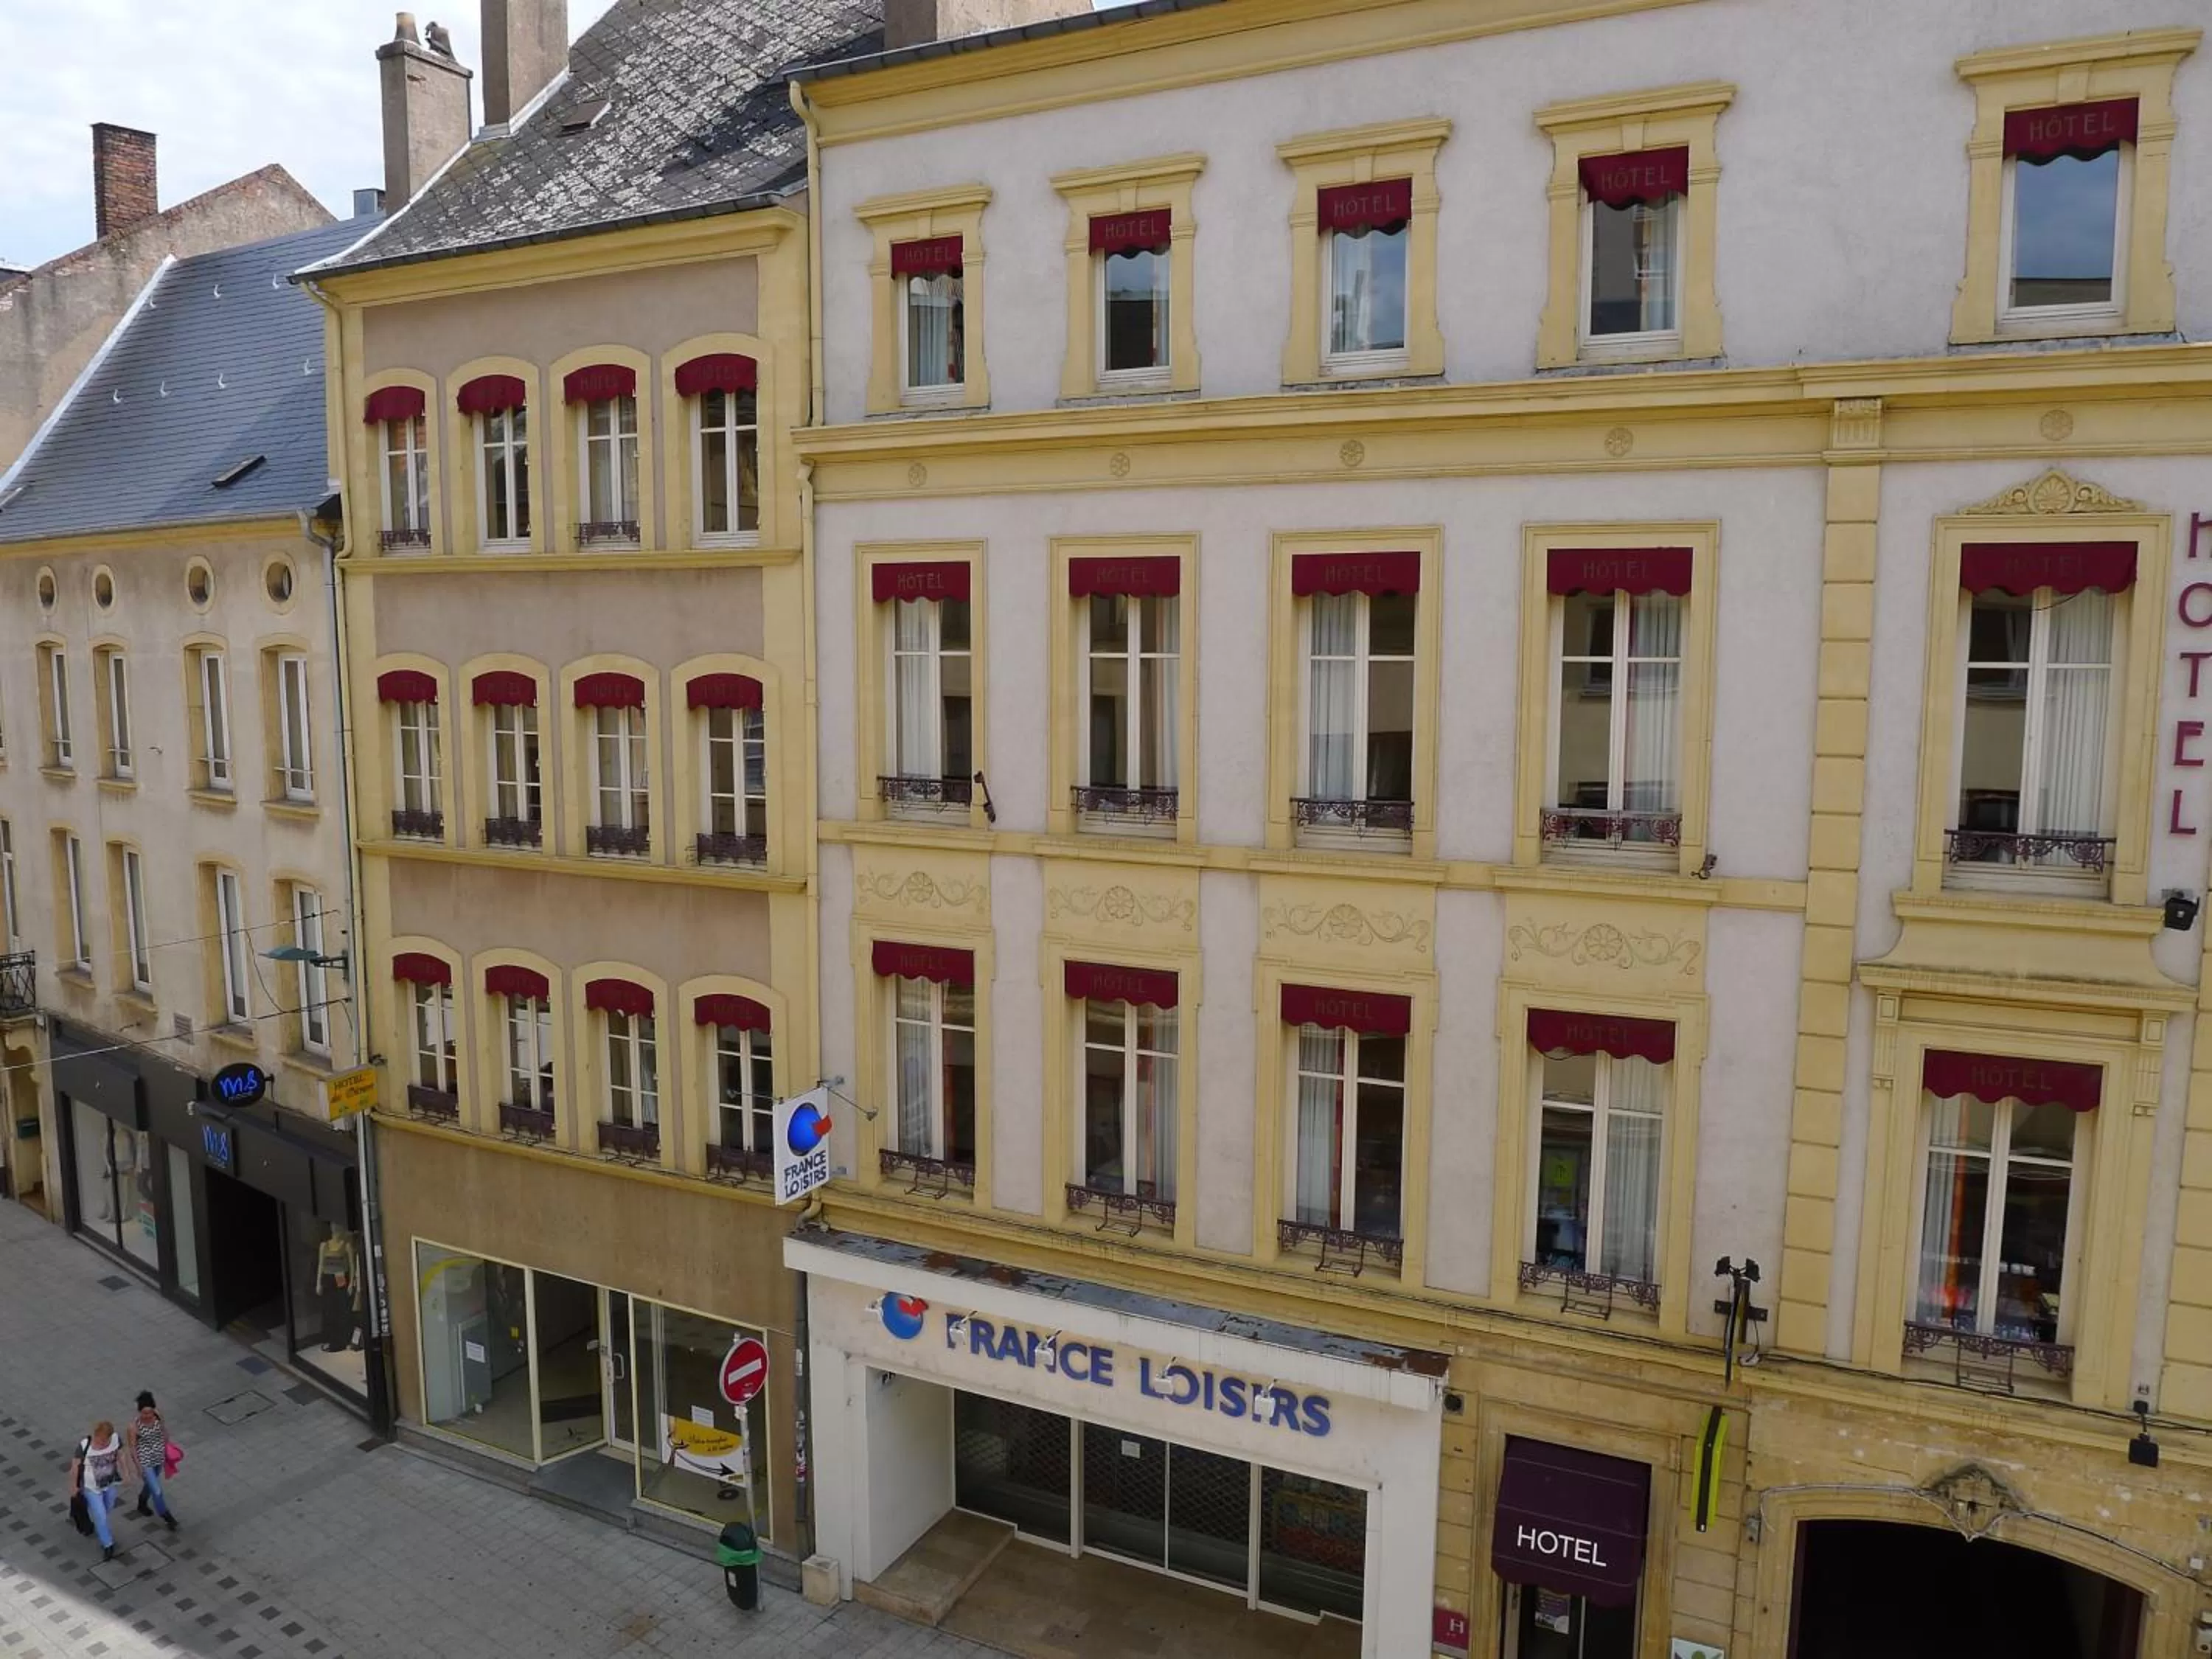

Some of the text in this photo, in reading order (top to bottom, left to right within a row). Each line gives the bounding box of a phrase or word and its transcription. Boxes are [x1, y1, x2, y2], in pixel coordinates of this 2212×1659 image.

[2170, 512, 2212, 835] HOTEL
[784, 1150, 827, 1183] FRANCE
[785, 1166, 827, 1198] LOISIRS
[945, 1312, 1114, 1387] FRANCE
[1517, 1524, 1607, 1568] HOTEL
